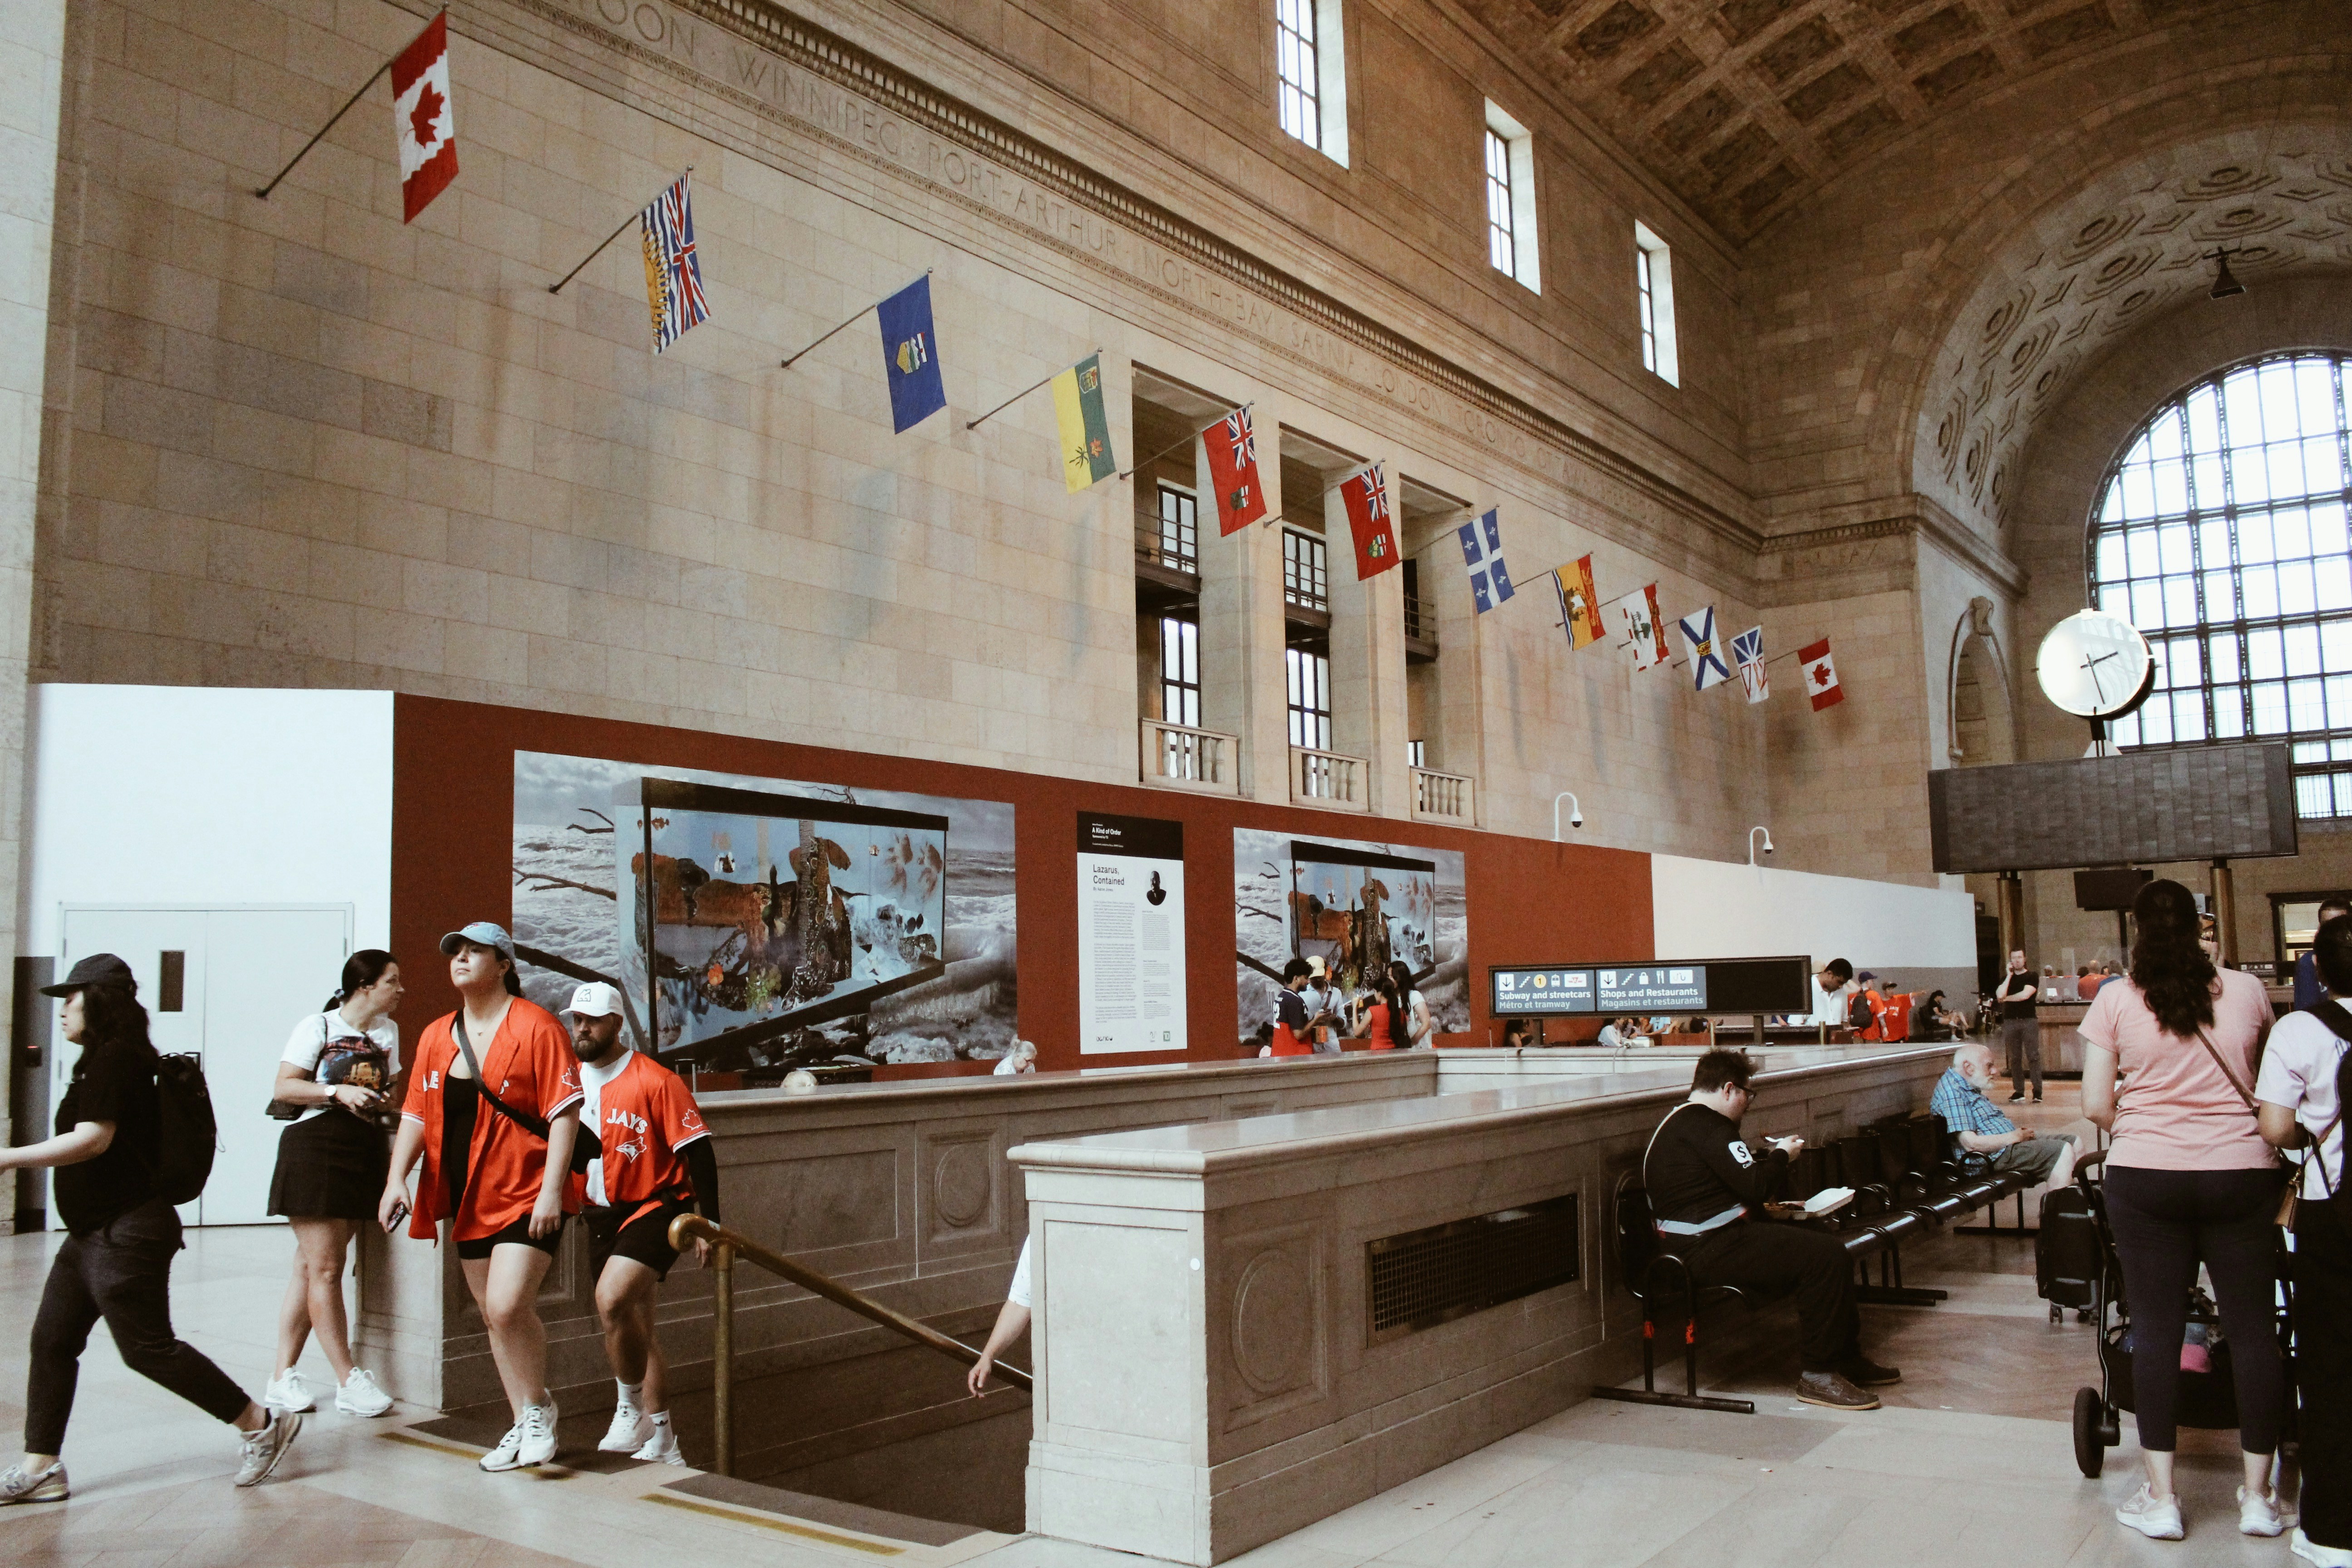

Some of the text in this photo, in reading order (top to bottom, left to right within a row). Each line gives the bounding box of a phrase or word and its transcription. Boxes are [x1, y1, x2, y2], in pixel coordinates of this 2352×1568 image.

[735, 47, 900, 155] WINNIPEG
[928, 141, 1117, 256] PORT-ARTHUR
[1144, 252, 1274, 328] NORTH-BAY
[1374, 365, 1442, 416] LONDON
[1455, 402, 1525, 459] TORONTO
[1093, 864, 1119, 875] Lazarus,
[1093, 875, 1125, 886] Contained
[1499, 992, 1530, 1001] Subway
[1549, 990, 1591, 999] streetcars
[1600, 988, 1698, 999] Shops and Restaurants
[1535, 1001, 1570, 1009] tramway
[1602, 1000, 1640, 1009] Magasins
[1654, 996, 1703, 1005] restaurants
[606, 1108, 648, 1134] JAYS
